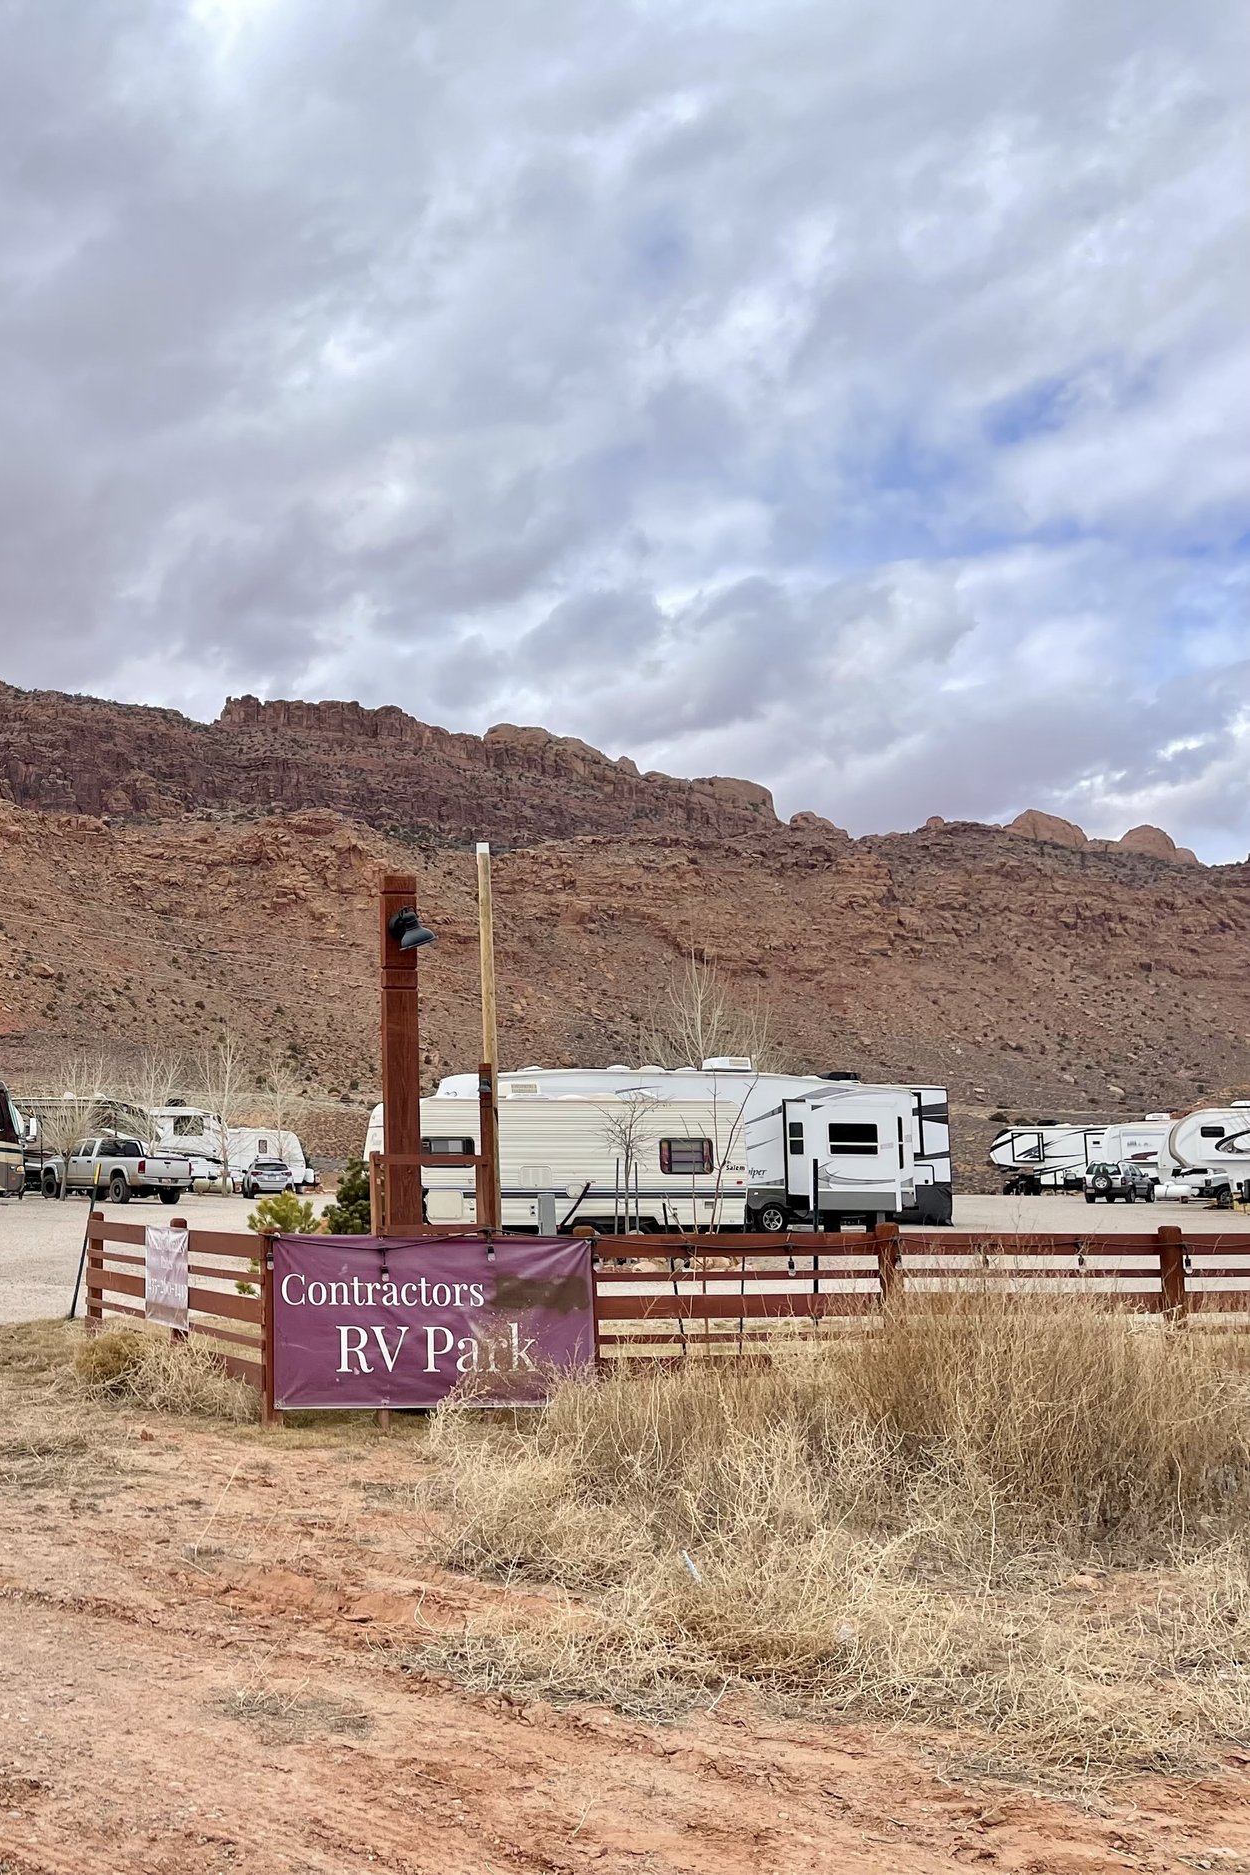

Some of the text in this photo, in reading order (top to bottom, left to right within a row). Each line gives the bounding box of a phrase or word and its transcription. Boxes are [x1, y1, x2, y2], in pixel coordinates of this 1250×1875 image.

[748, 1167, 767, 1178] iper
[281, 1273, 485, 1308] Contractors
[335, 1322, 540, 1374] RV Park
